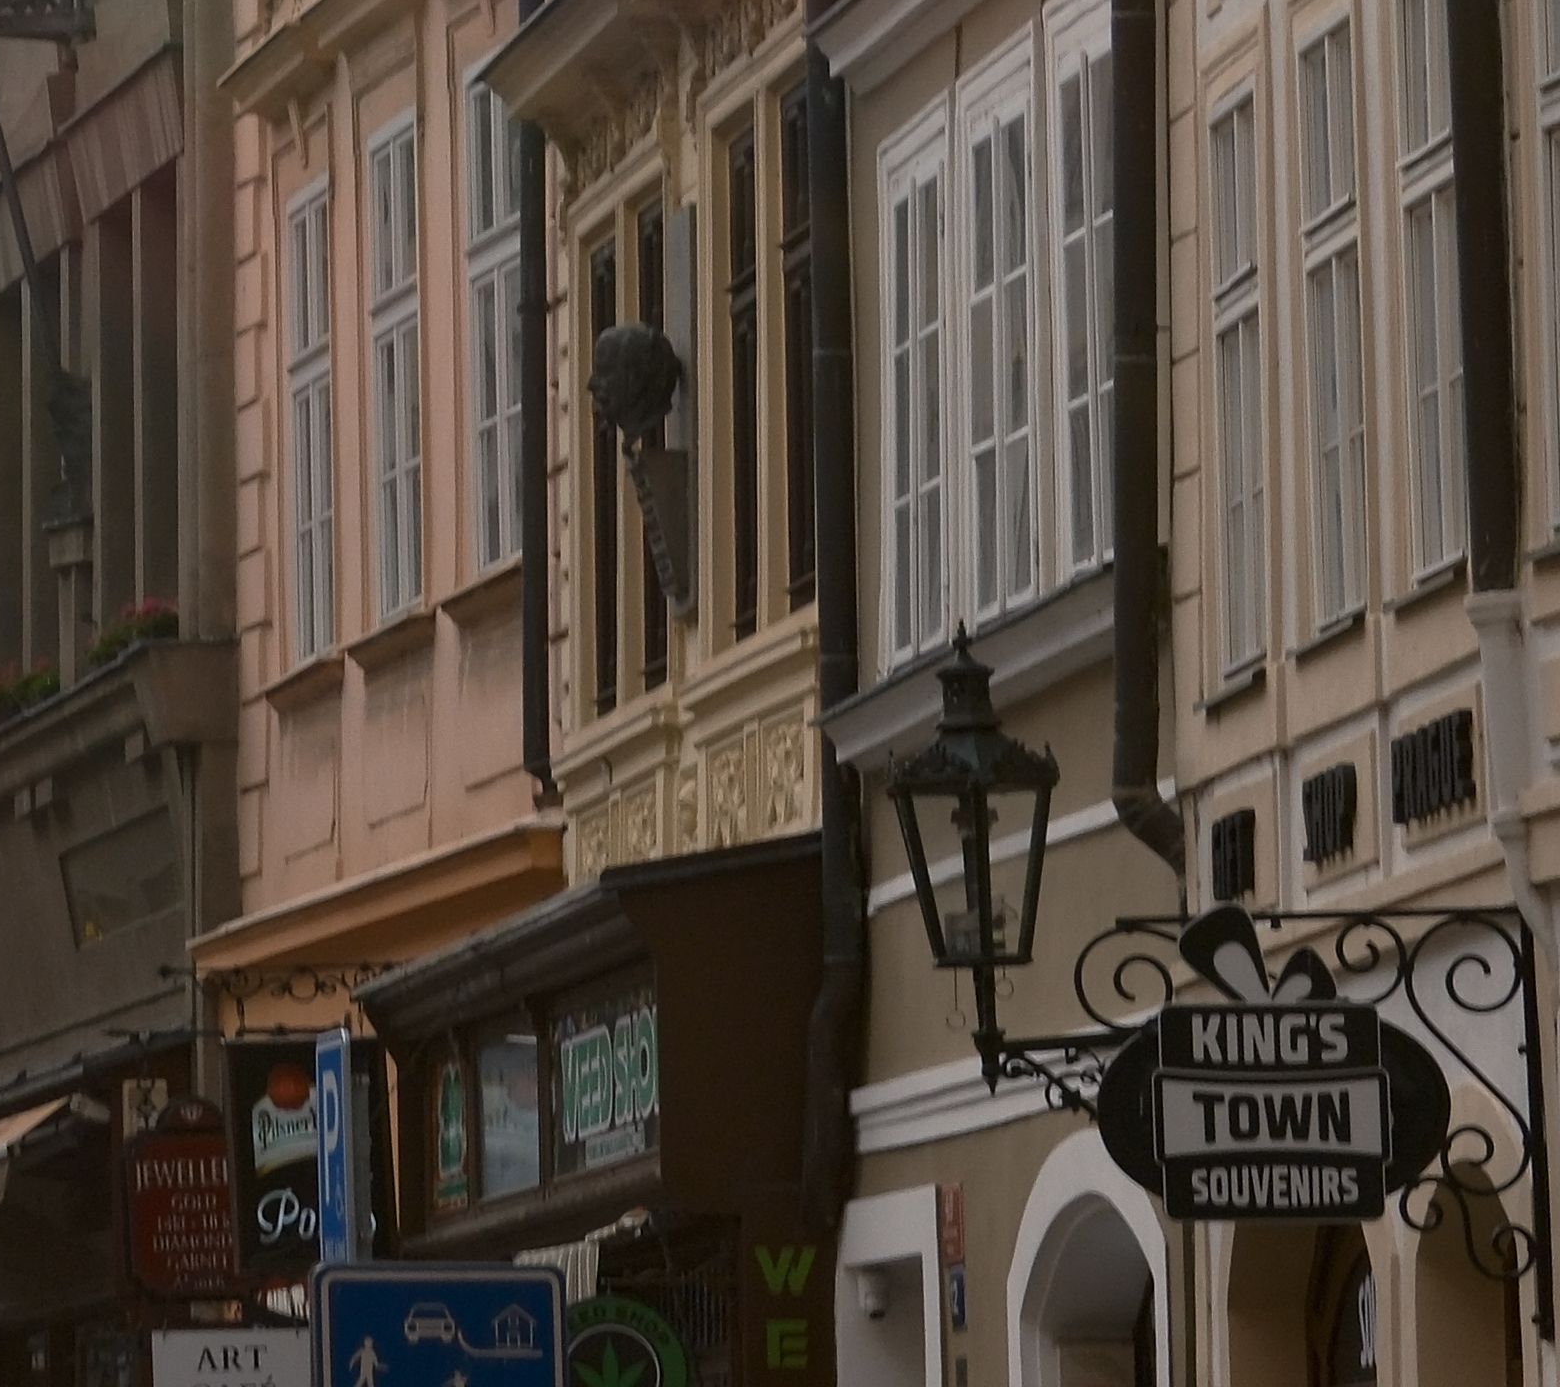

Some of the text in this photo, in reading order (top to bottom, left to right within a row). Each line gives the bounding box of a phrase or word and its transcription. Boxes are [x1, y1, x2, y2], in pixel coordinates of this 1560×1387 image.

[1391, 710, 1475, 823] PRAGUE
[614, 1005, 659, 1124] SHO
[1191, 1013, 1349, 1066] KING'S
[1192, 1090, 1351, 1144] TOWN
[170, 1193, 217, 1212] GOLD
[1191, 1164, 1359, 1208] SOUVENIRS
[198, 1344, 267, 1372] ART
